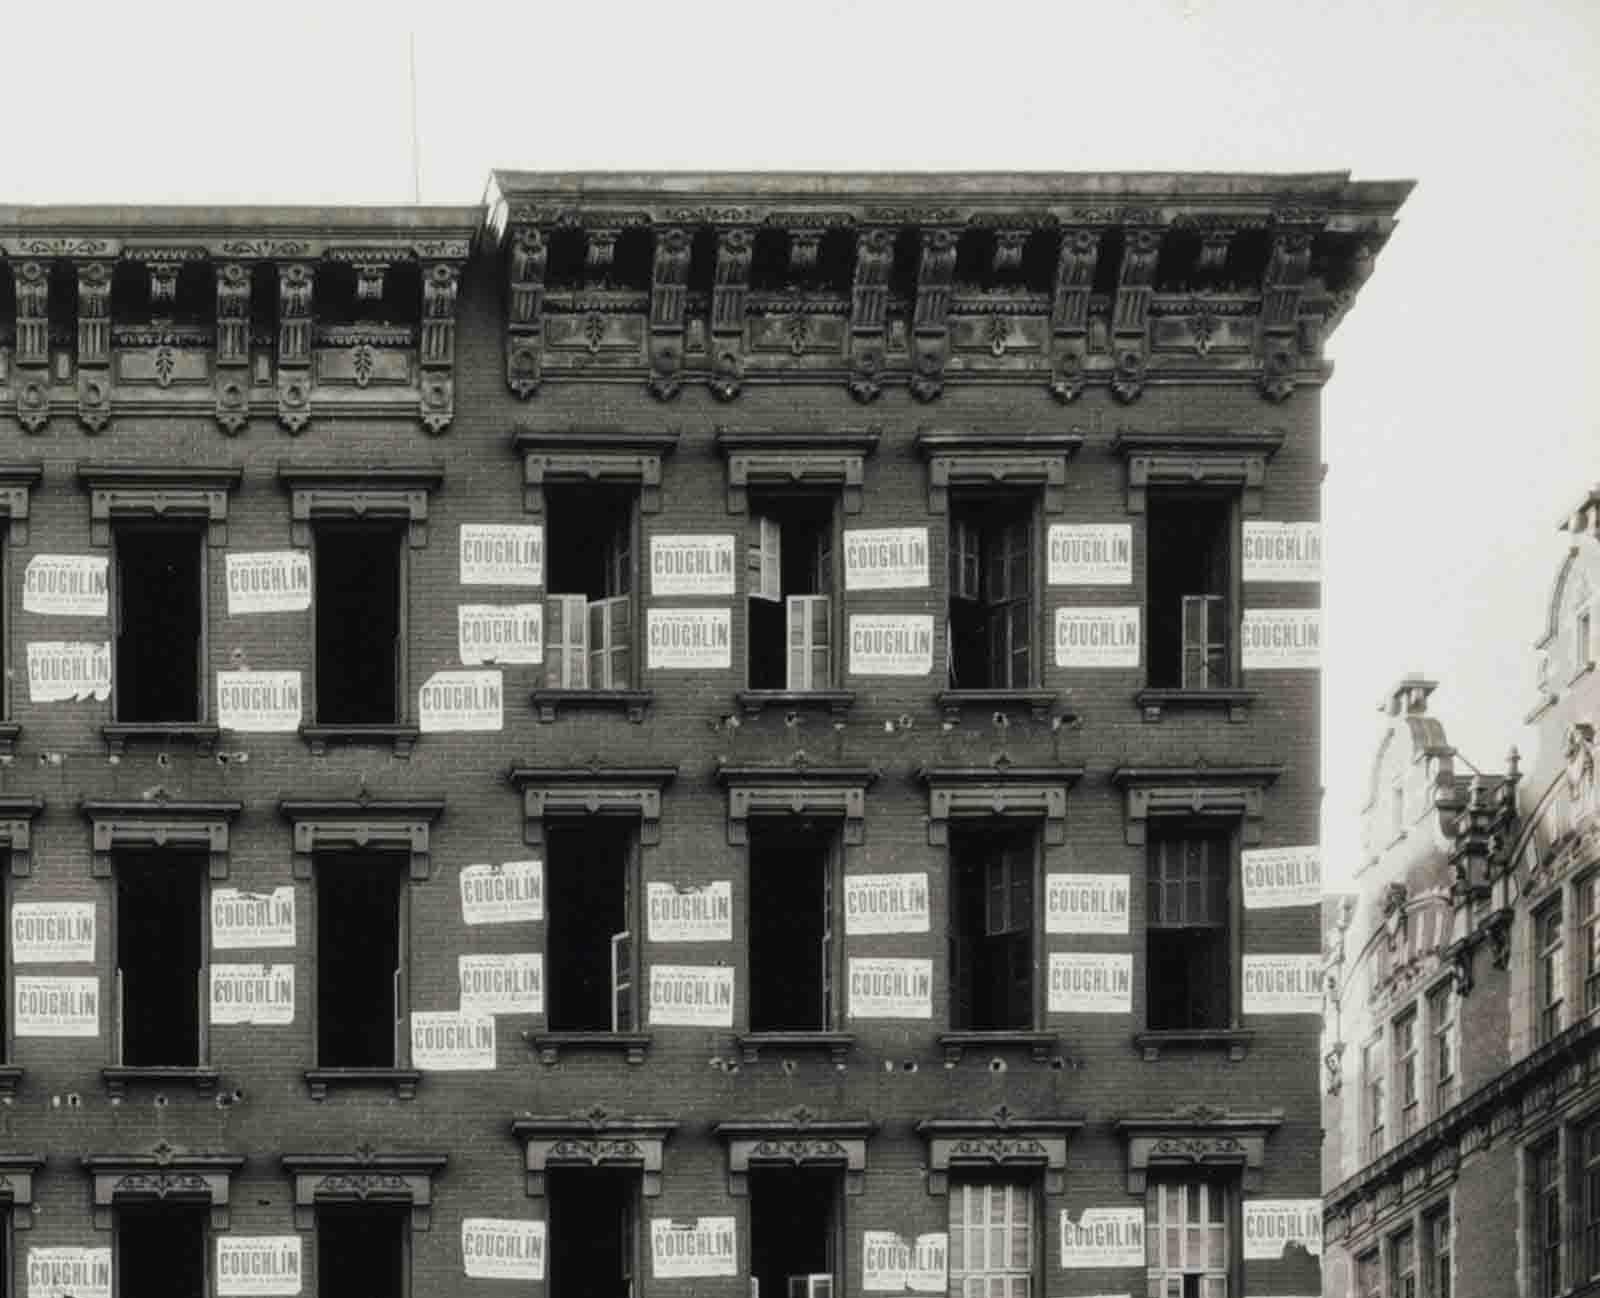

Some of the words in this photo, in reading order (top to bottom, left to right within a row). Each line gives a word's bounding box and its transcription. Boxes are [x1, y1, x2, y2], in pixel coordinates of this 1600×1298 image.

[463, 539, 543, 563] COUGHLIN
[655, 550, 732, 573] COUGHLIN
[230, 566, 307, 591] COUGHLIN
[461, 619, 541, 643] COUGHLIN
[650, 623, 730, 647] COUGHLIN
[1058, 622, 1138, 646] COUGHLIN
[422, 686, 502, 710] COUGHLIN
[1245, 862, 1322, 887] COUGHLIN
[650, 897, 730, 921] COUGHLIN
[1050, 889, 1126, 914] COUGHLIN
[463, 969, 540, 992] COUGHLIN
[653, 980, 733, 1004] COUGHLIN
[1246, 969, 1322, 994] COUGHLIN
[19, 991, 96, 1014] COUGHLIN
[414, 1025, 494, 1049] COUGHLIN
[655, 1233, 735, 1257] COUGHLIN
[1064, 1223, 1144, 1247] COUGHLIN
